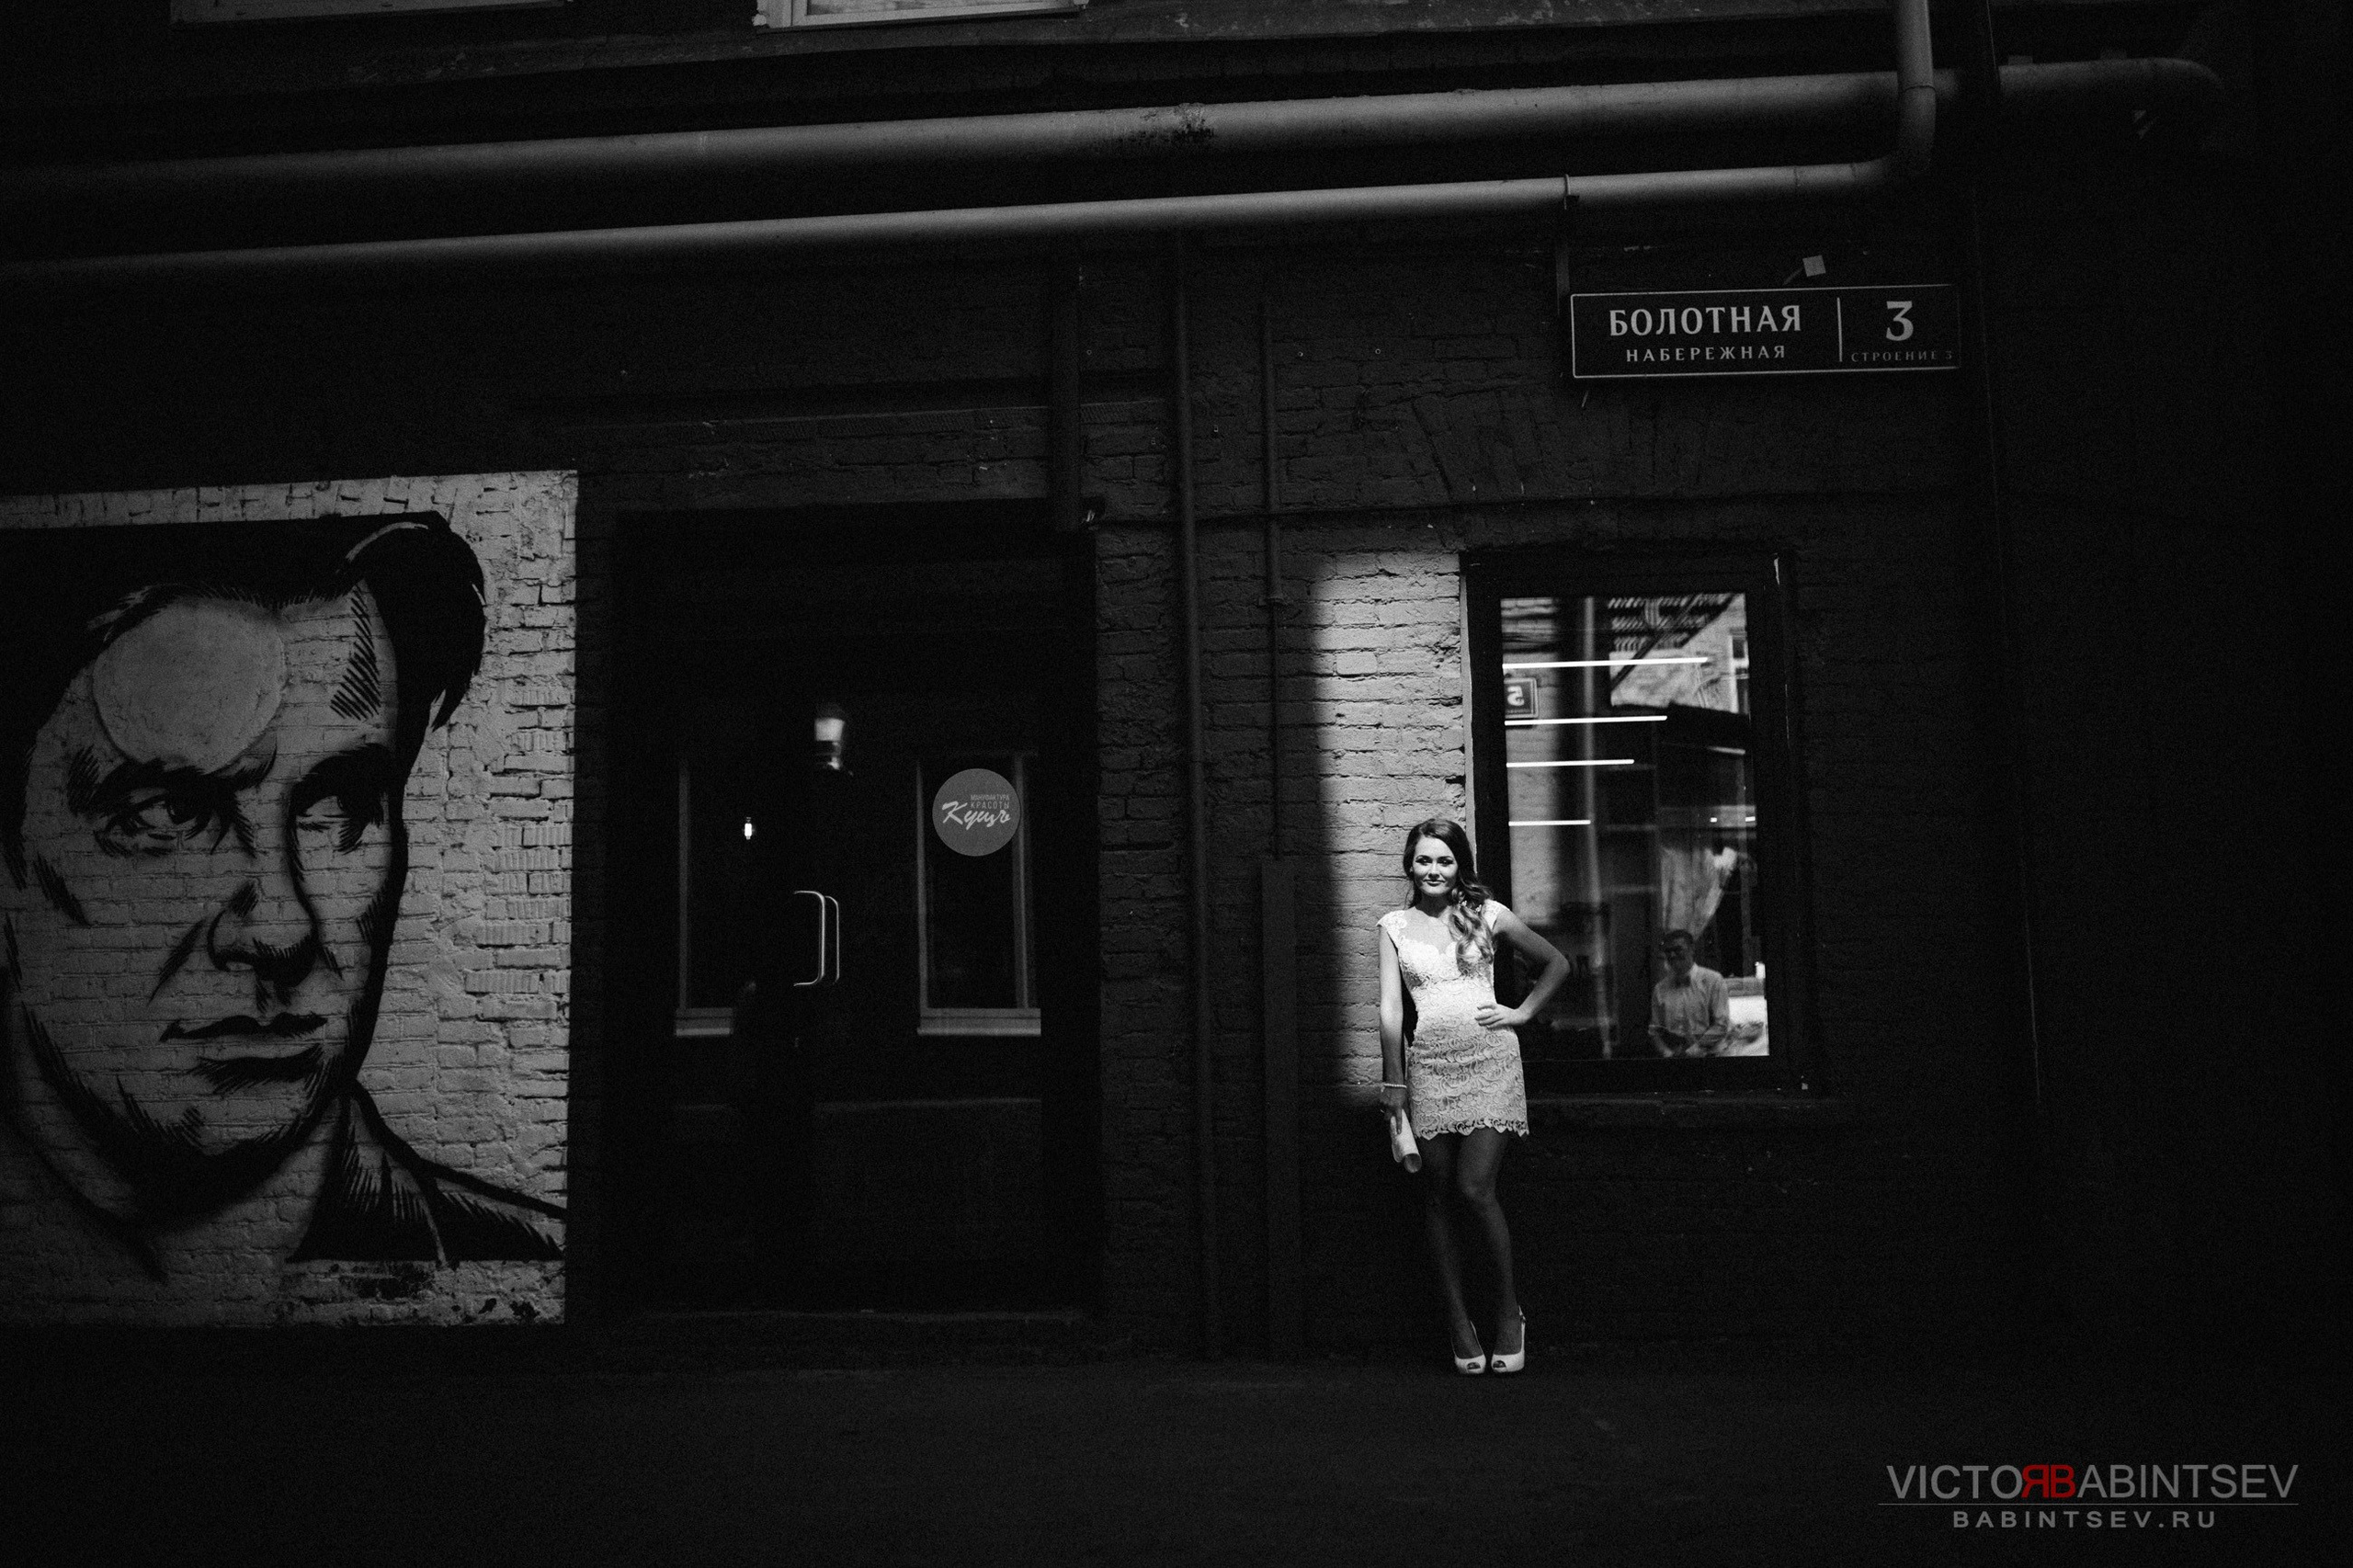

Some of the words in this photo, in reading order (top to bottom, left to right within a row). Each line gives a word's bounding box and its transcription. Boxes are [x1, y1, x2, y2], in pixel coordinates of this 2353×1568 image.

[1609, 304, 1802, 336] БОЛОТНАЯ
[1885, 301, 1915, 342] 3
[1626, 345, 1785, 362] НАБЕРЕЖНАЯ
[1850, 350, 1938, 362] СТРОЕНИЕ
[970, 801, 1010, 809] КРАСОТЫ
